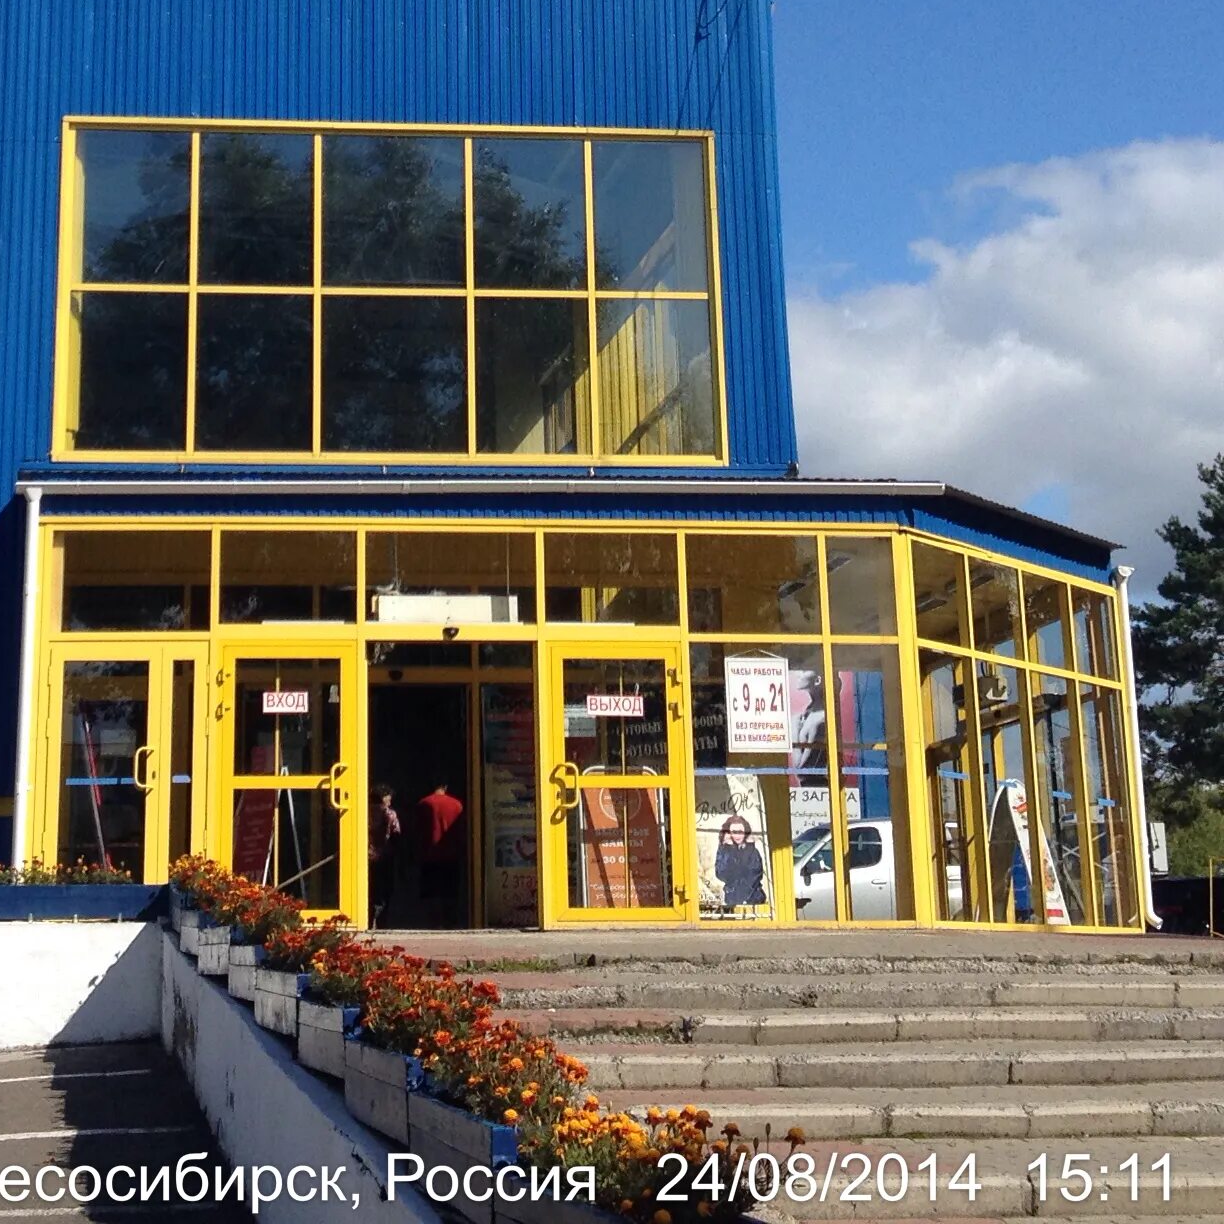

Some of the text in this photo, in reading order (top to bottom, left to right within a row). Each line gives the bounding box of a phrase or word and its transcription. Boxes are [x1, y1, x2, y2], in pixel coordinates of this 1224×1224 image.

[731, 668, 782, 676] ЧАСЫ РАБОТЫ
[265, 693, 307, 711] ВХОД
[588, 697, 643, 715] ВЫХОД
[742, 683, 751, 712] 9
[769, 683, 784, 712] 21
